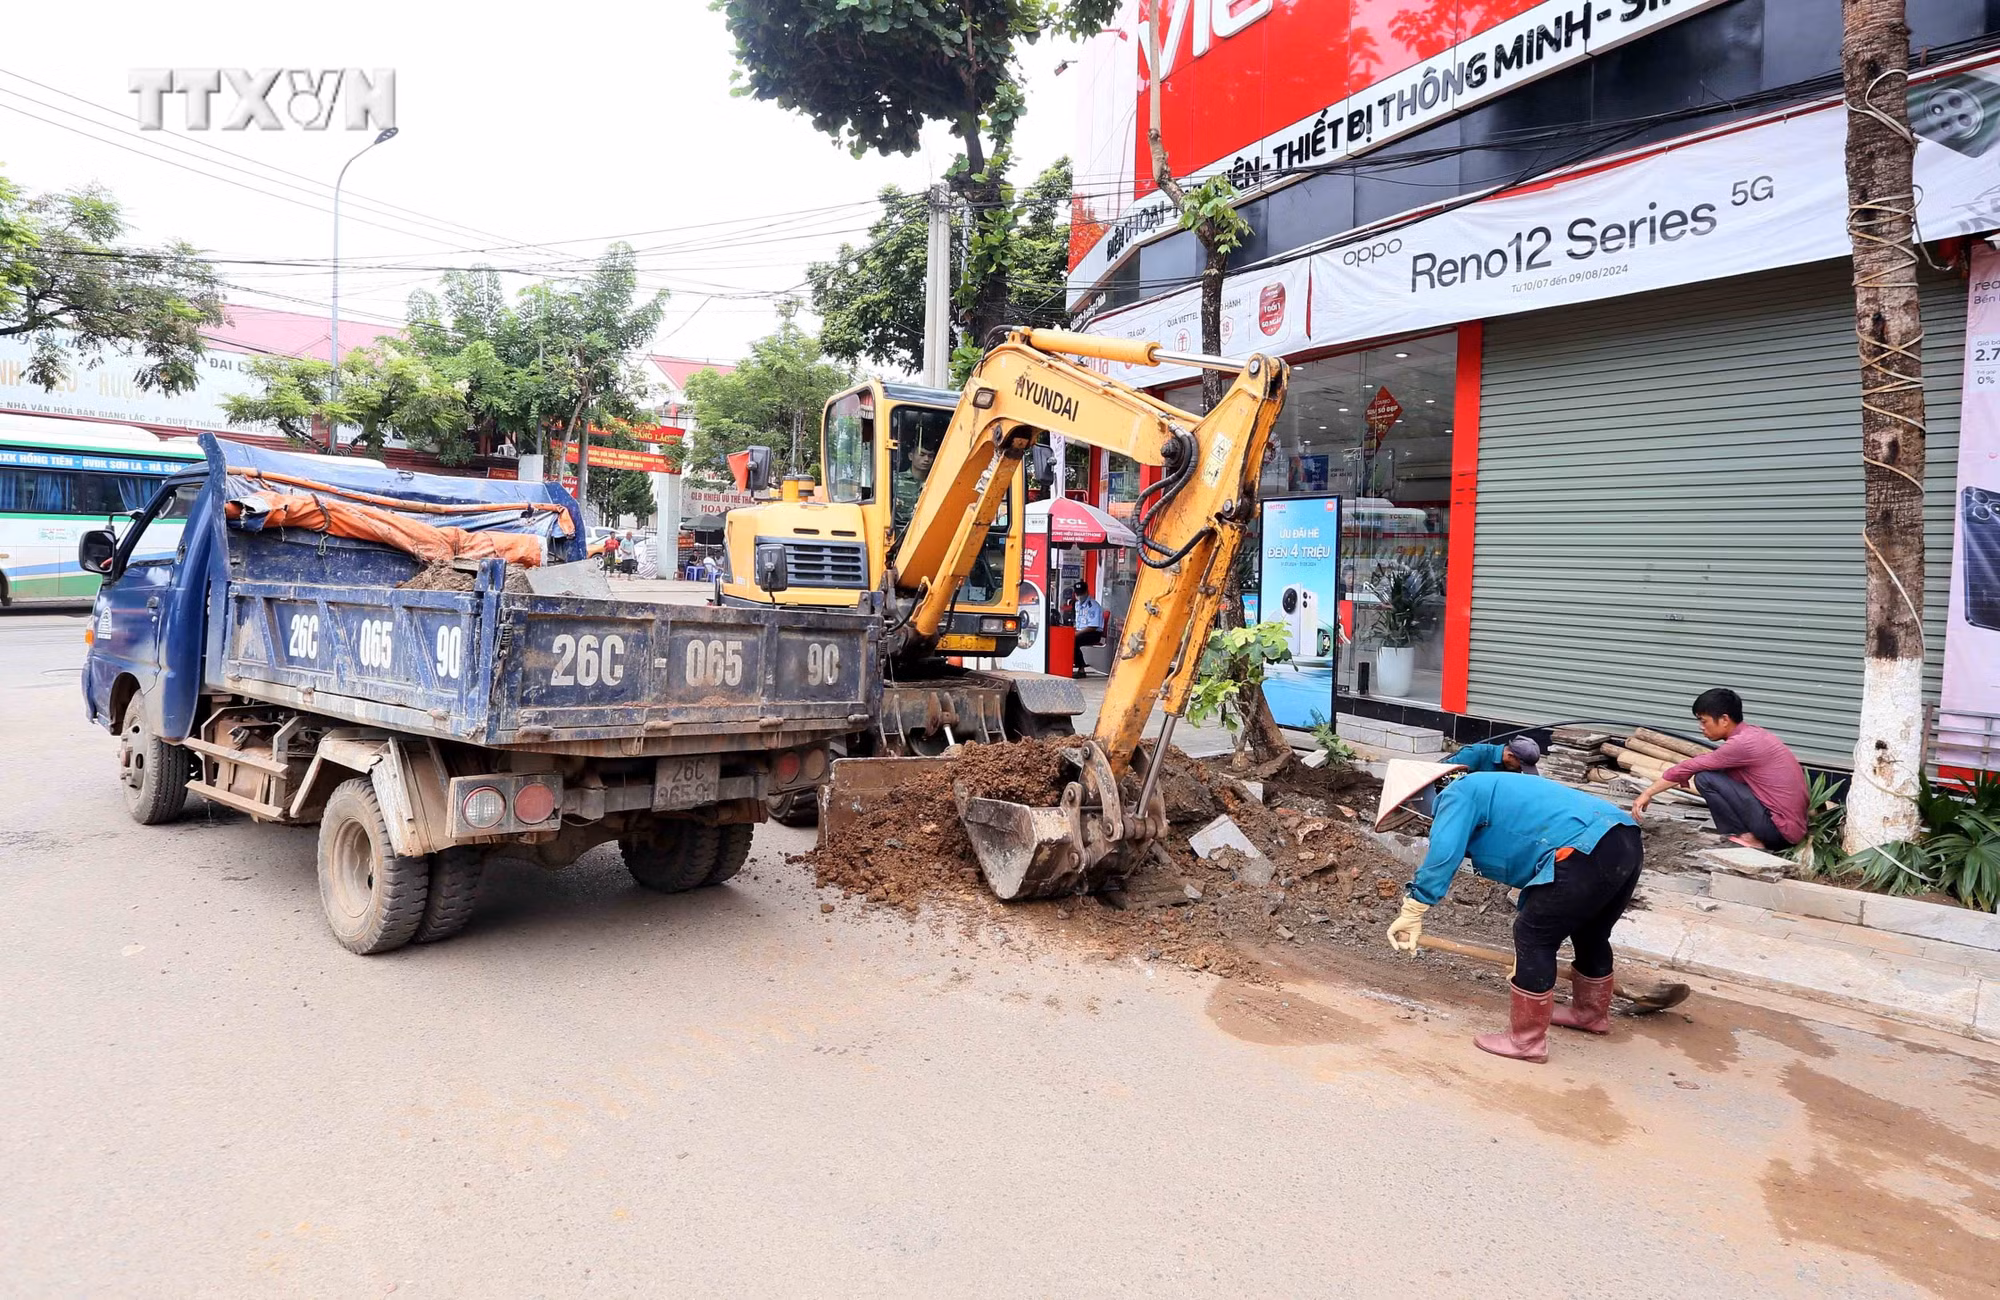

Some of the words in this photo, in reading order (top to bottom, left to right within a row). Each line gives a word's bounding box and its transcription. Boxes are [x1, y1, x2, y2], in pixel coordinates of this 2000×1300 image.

[1273, 108, 1344, 173] THIẾT
[1347, 104, 1372, 142] BỊ
[1378, 52, 1487, 127] THÔNG
[1494, 2, 1592, 79] MINH
[1411, 226, 1553, 293] Reno12
[1566, 201, 1717, 260] Series
[1731, 175, 1774, 207] 5G
[1523, 278, 1549, 291] 10/07
[1568, 264, 1629, 283] 09/08/2024
[1179, 312, 1199, 324] VIETTEL
[1977, 376, 1996, 384] 0%
[1014, 377, 1079, 422] HYUNDAI
[0, 453, 17, 463] XK
[701, 504, 721, 513] HOA
[1290, 544, 1299, 558] 4
[1301, 544, 1330, 561] TRIỆU
[289, 614, 319, 660] 26C
[359, 618, 393, 669] 065
[436, 625, 462, 679] 90
[550, 634, 625, 687] 26C
[686, 640, 743, 687] 065
[807, 643, 840, 687] 90
[672, 759, 705, 783] 26C
